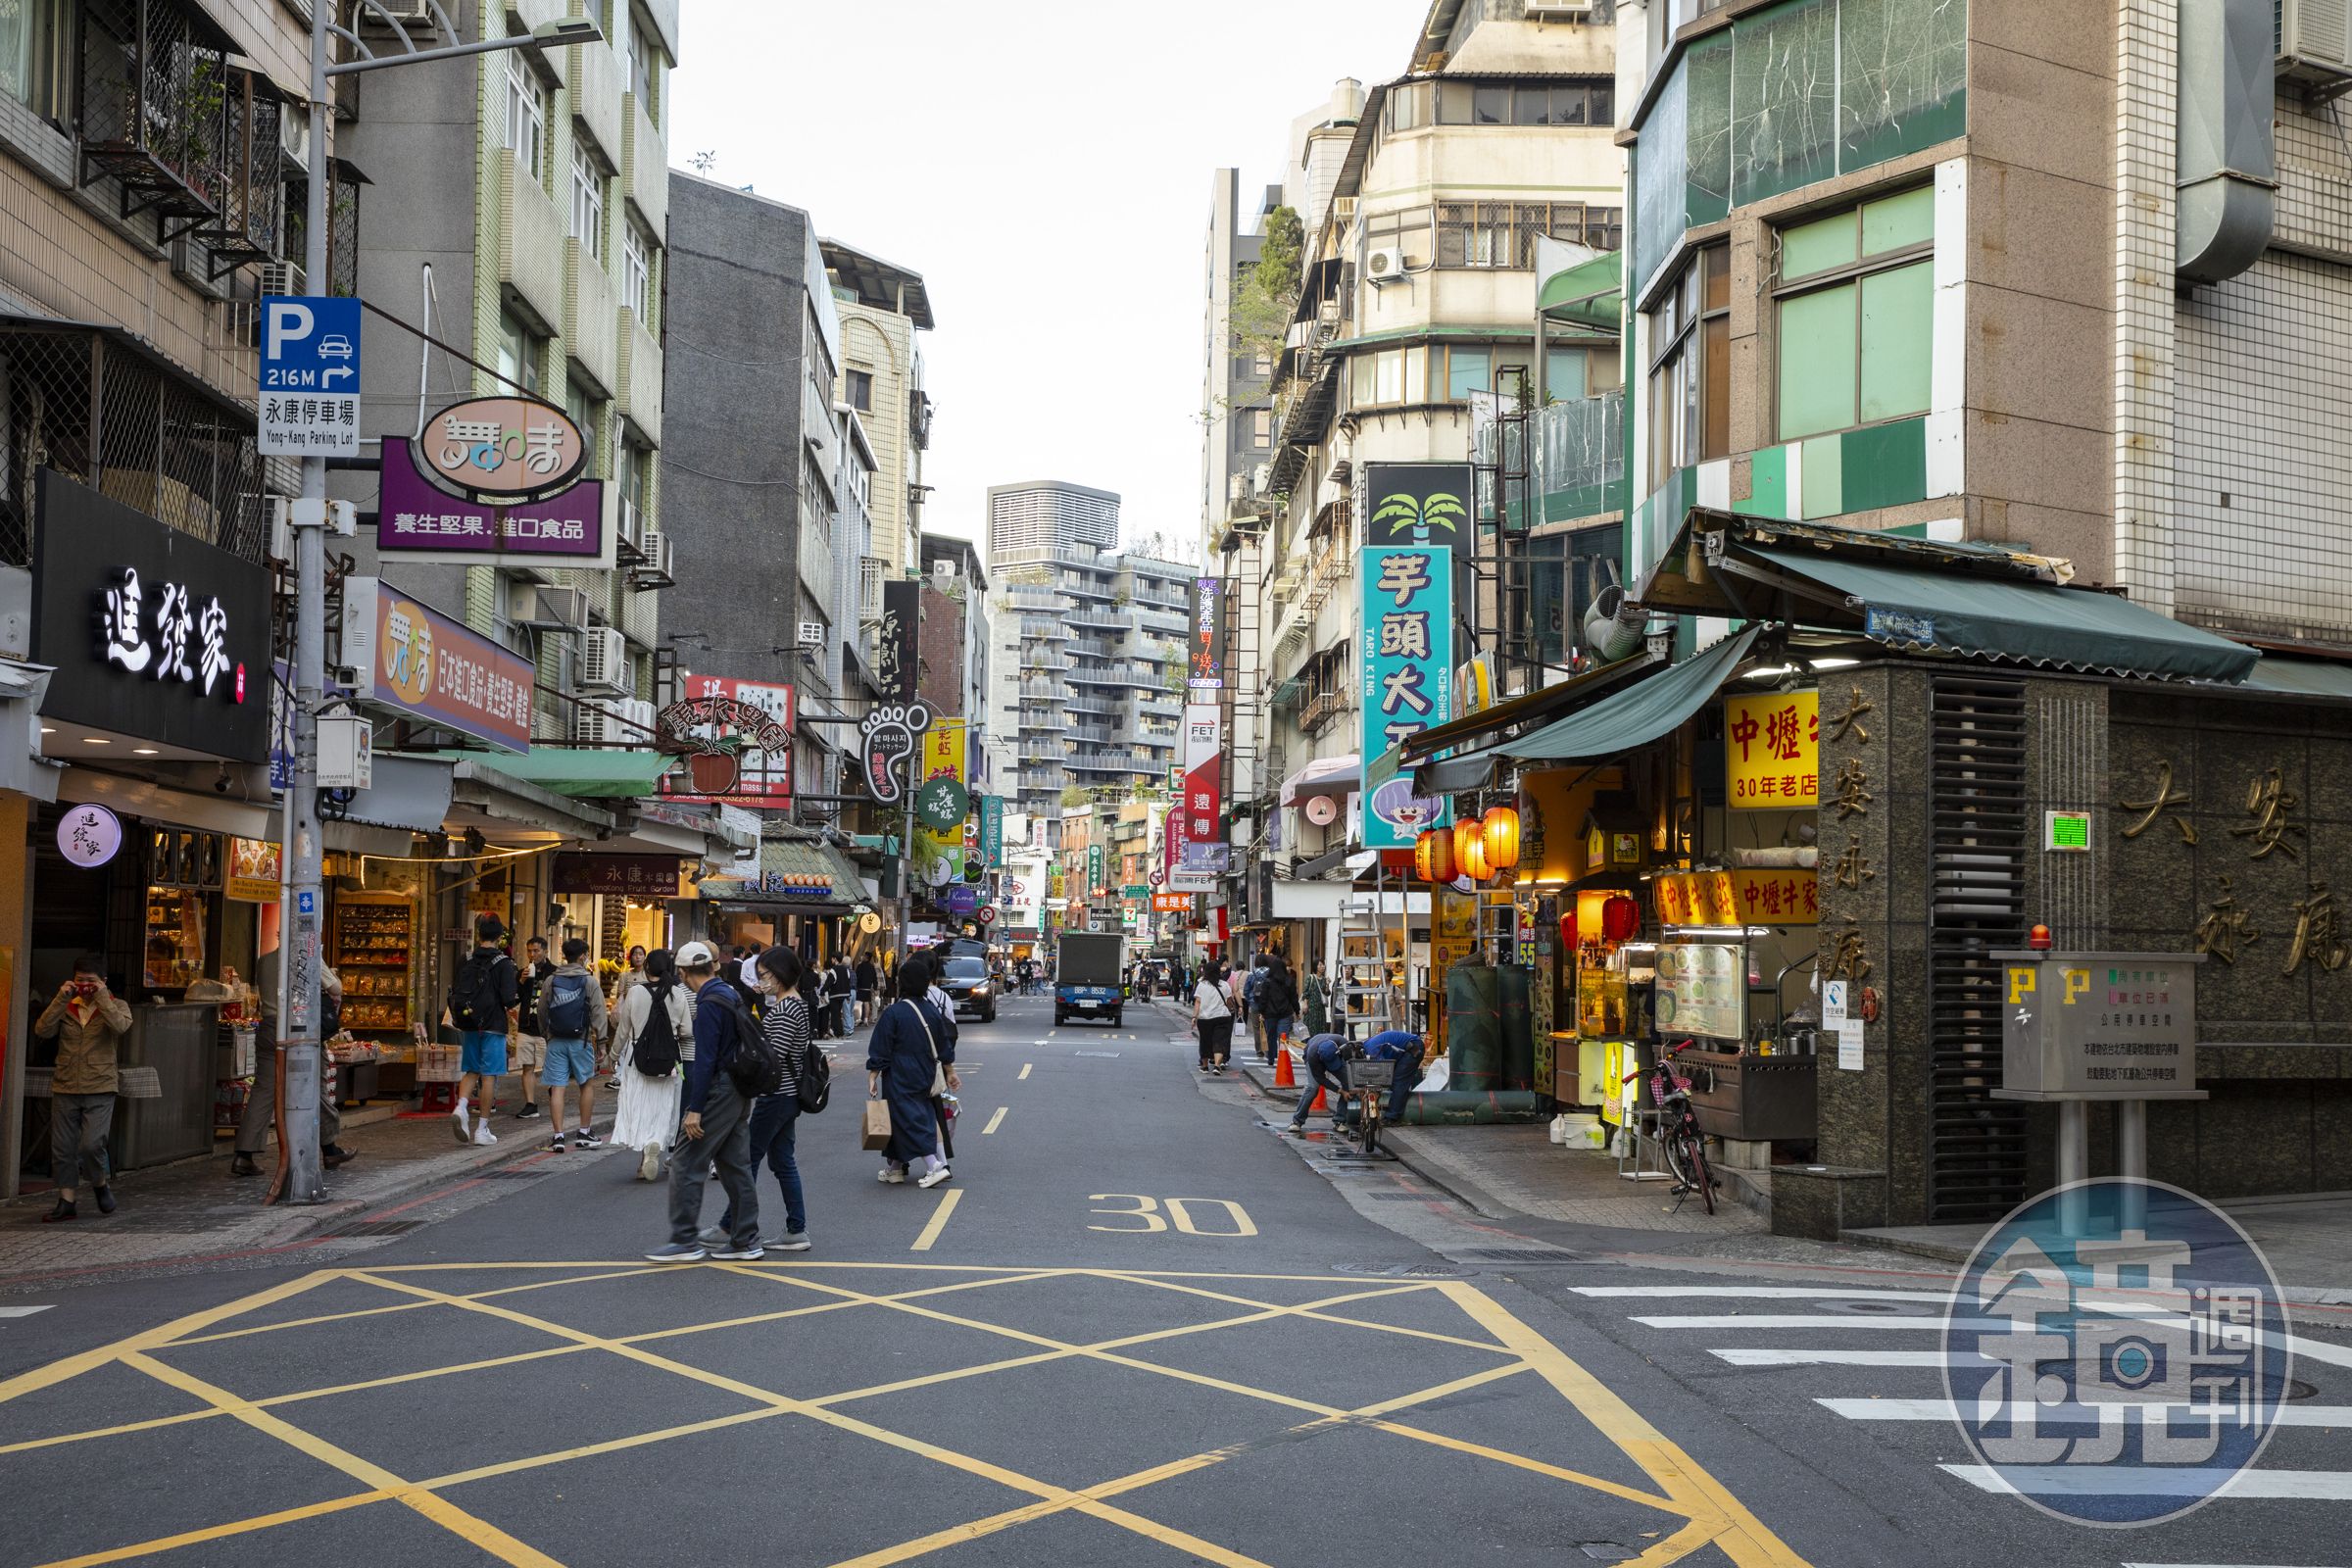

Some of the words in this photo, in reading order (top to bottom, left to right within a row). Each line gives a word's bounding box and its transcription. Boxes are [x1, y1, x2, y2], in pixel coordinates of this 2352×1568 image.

[268, 303, 315, 360] P
[267, 368, 315, 387] 216M
[265, 397, 355, 426] 永康停車場
[267, 429, 306, 447] Yong-Kang
[310, 431, 337, 446] Parking
[340, 432, 354, 445] Lot
[1365, 627, 1375, 659] TARO
[1365, 665, 1375, 697] KING
[1191, 726, 1215, 735] FET
[1737, 774, 1818, 799] 30年老店
[1194, 793, 1210, 836] 遠傳
[952, 891, 974, 902] Kimo
[1155, 896, 1191, 908] 康是美
[2008, 968, 2035, 1004] P
[2063, 968, 2090, 1004] P
[1087, 1194, 1258, 1236] 30
